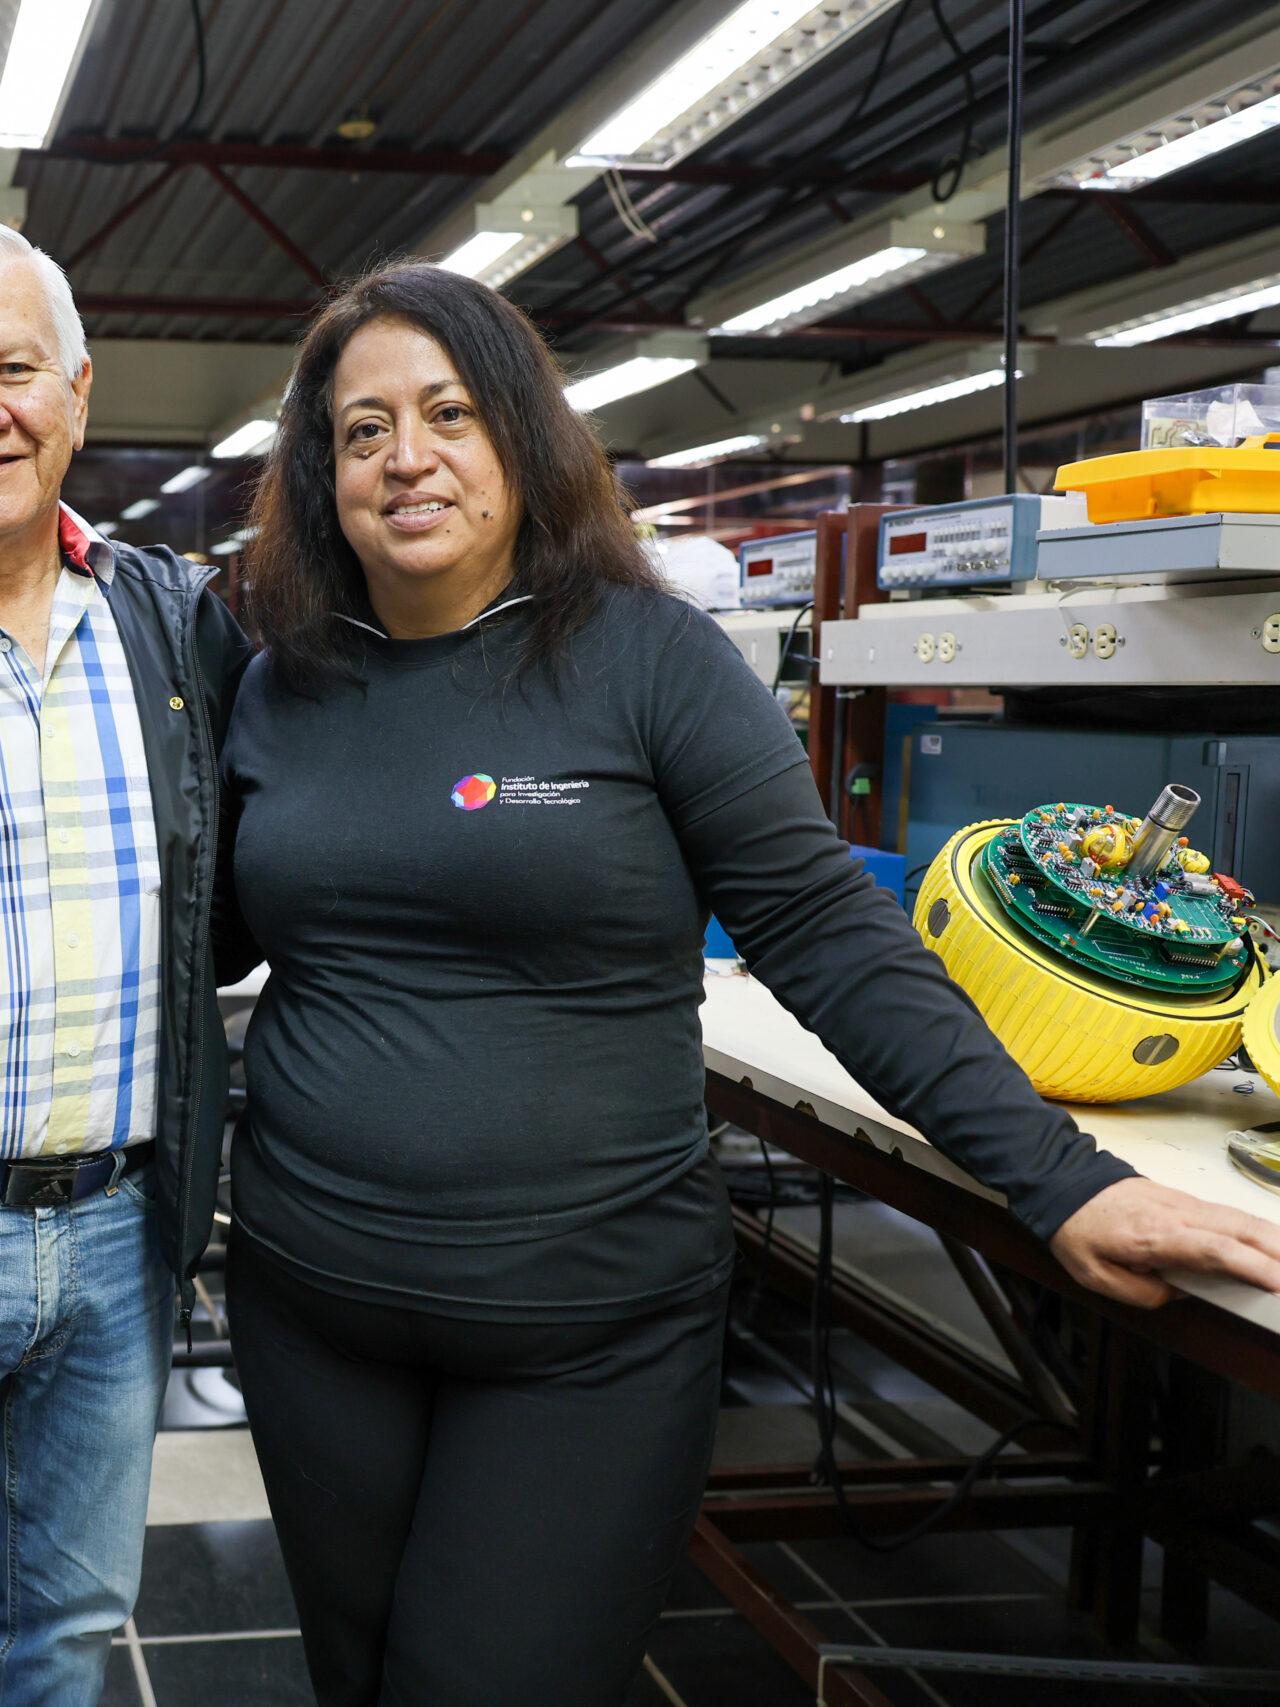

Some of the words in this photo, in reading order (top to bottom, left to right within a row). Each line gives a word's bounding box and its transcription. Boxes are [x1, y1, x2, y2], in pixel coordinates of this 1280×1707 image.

[501, 783, 538, 791] Instituto
[539, 781, 550, 790] de
[551, 780, 590, 791] Ingeniería
